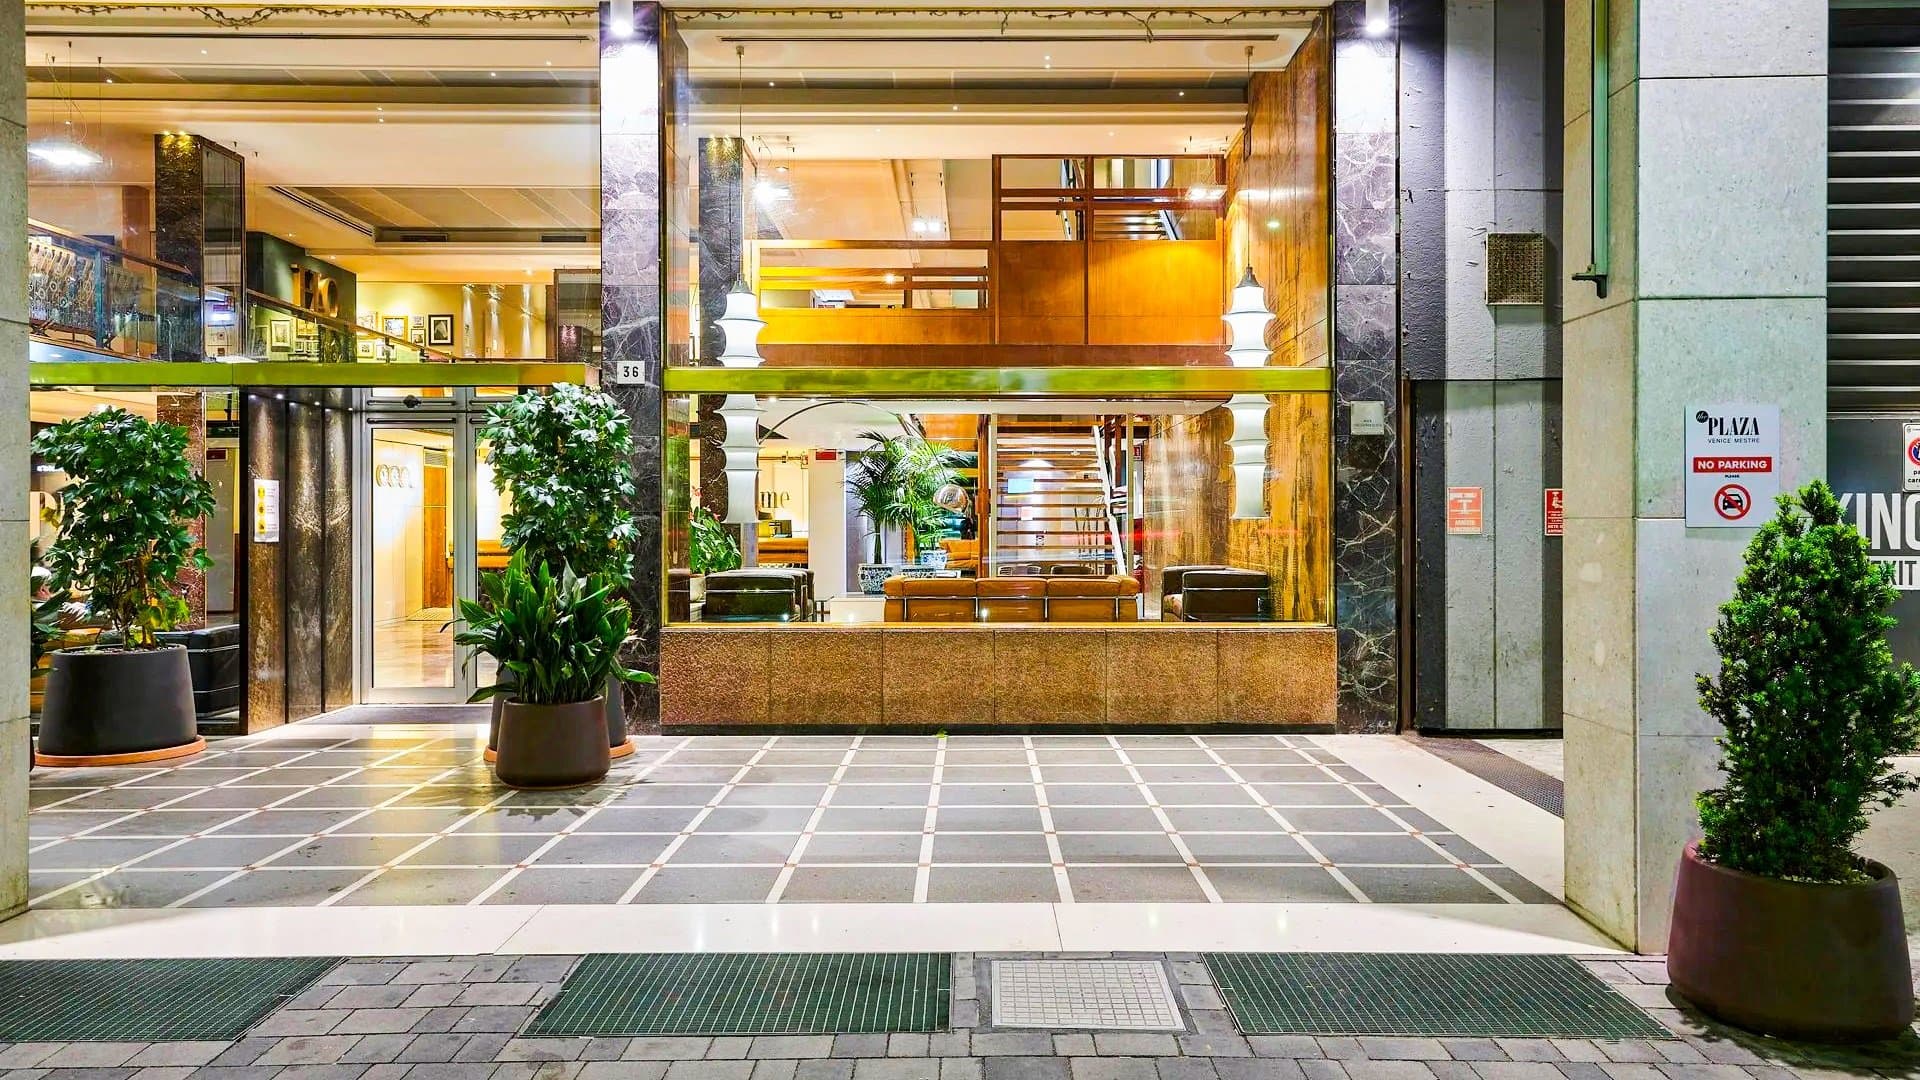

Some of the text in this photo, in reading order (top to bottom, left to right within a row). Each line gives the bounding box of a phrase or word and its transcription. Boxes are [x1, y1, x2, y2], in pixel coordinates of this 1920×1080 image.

[623, 366, 639, 378] 36
[1707, 417, 1760, 436] PLAZA
[1697, 460, 1768, 470] NO PARKING
[1870, 560, 1917, 585] XIT
